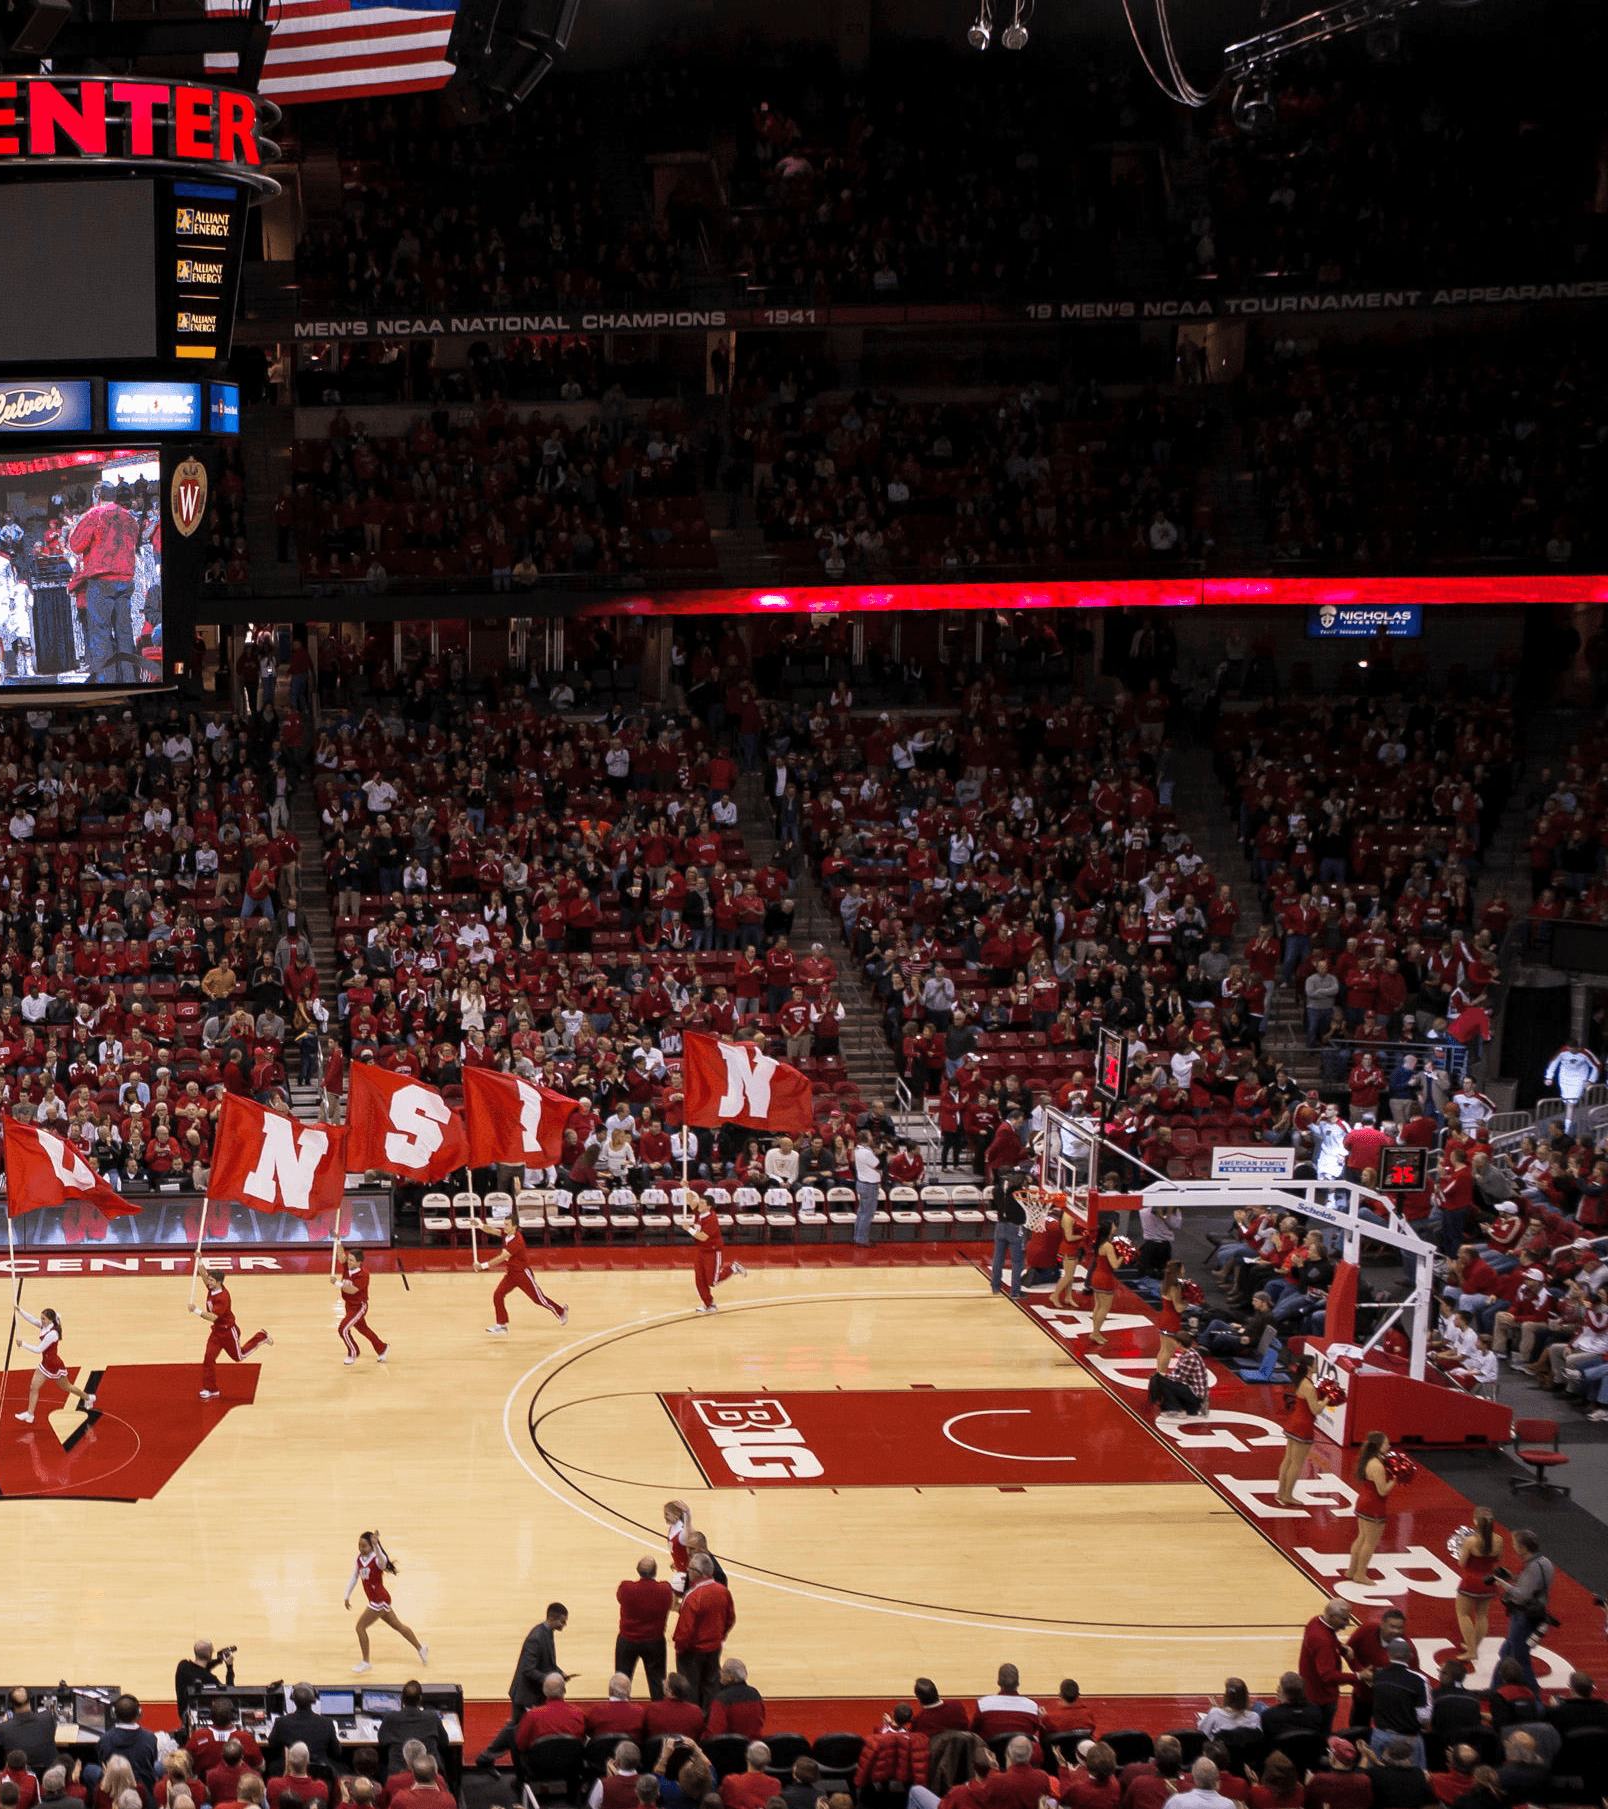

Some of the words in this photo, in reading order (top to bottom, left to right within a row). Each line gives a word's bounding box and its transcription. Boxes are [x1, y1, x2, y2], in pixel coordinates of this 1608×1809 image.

[195, 210, 230, 225] ALLIANT
[193, 262, 223, 274] ALLIANT
[1061, 302, 1135, 318] MEN'S
[1144, 300, 1214, 316] NCAA
[1225, 290, 1422, 314] TOURNAMENT
[191, 314, 217, 325] ALLIANT
[294, 321, 368, 337] MEN'S
[377, 319, 444, 334] NCAA
[451, 316, 570, 332] NATIONAL
[582, 311, 726, 330] CHAMPIONS
[764, 309, 816, 324] 1941
[179, 483, 200, 521] W
[1339, 611, 1411, 620] NICHOLAS
[717, 1042, 780, 1119] N
[385, 1084, 452, 1169] S
[243, 1111, 329, 1210] N
[1392, 1167, 1414, 1183] 35
[1297, 1203, 1336, 1221] Schelde
